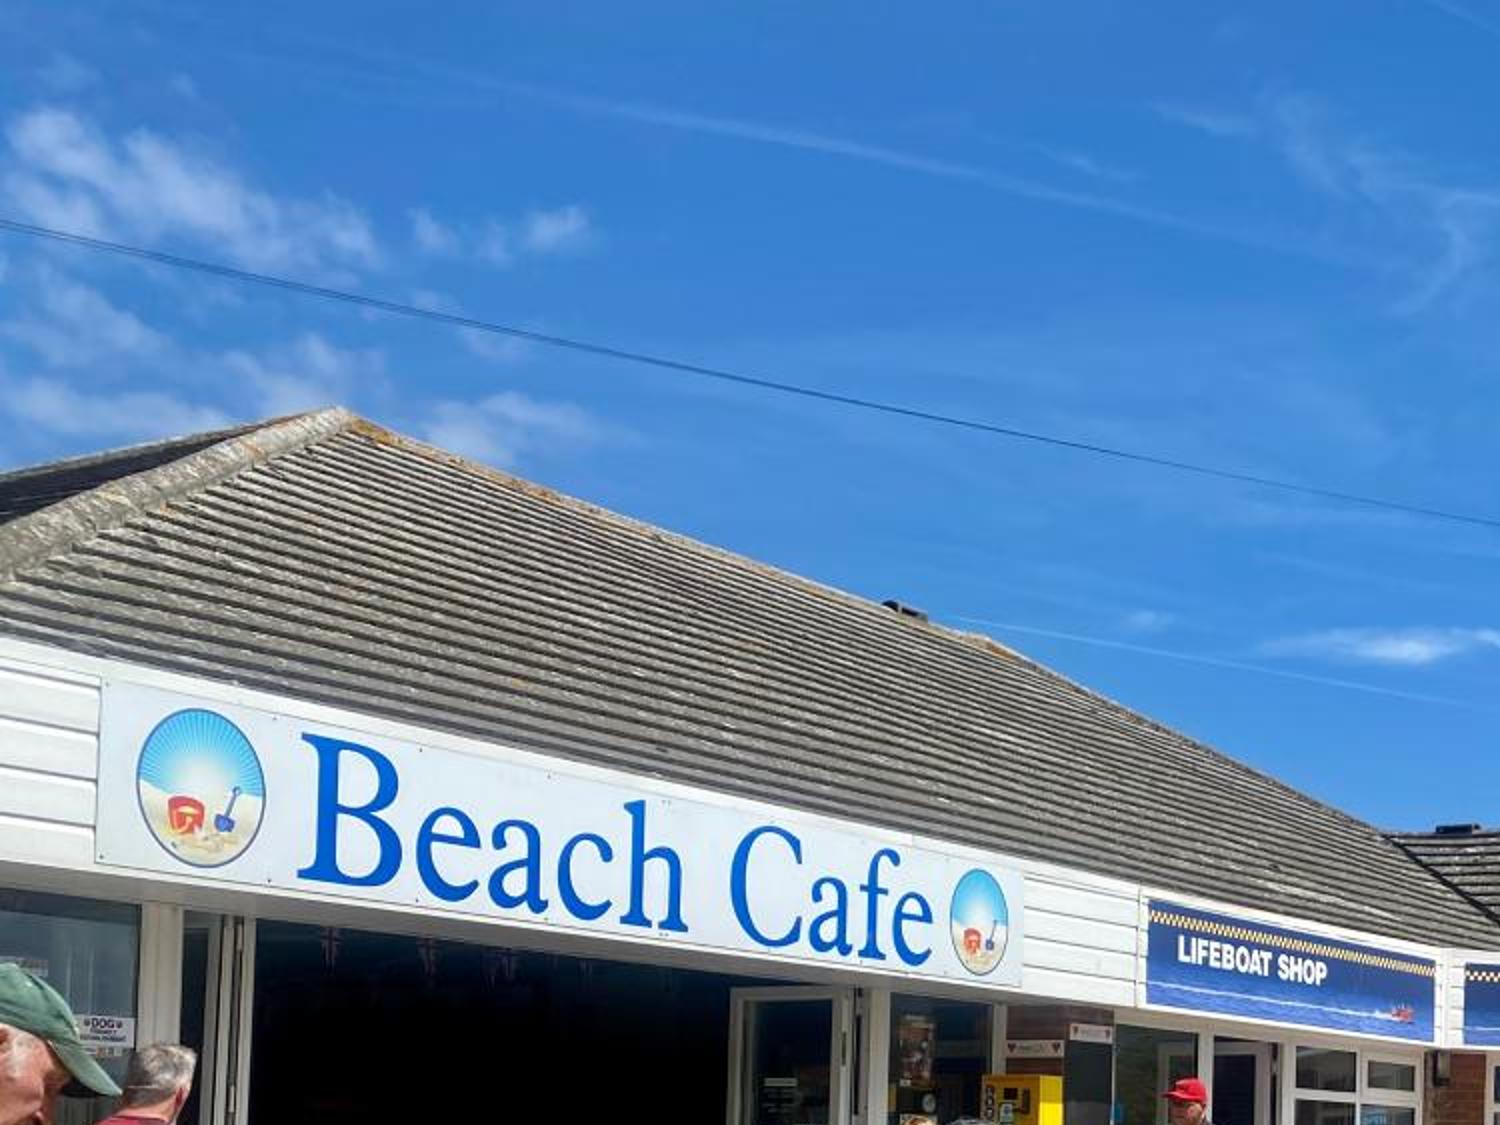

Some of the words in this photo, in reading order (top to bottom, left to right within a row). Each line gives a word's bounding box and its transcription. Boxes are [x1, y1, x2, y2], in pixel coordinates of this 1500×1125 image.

[297, 733, 688, 932] Beach
[730, 824, 933, 967] Cafe
[1178, 934, 1272, 977] LIFEBOAT
[1278, 954, 1328, 986] SHOP
